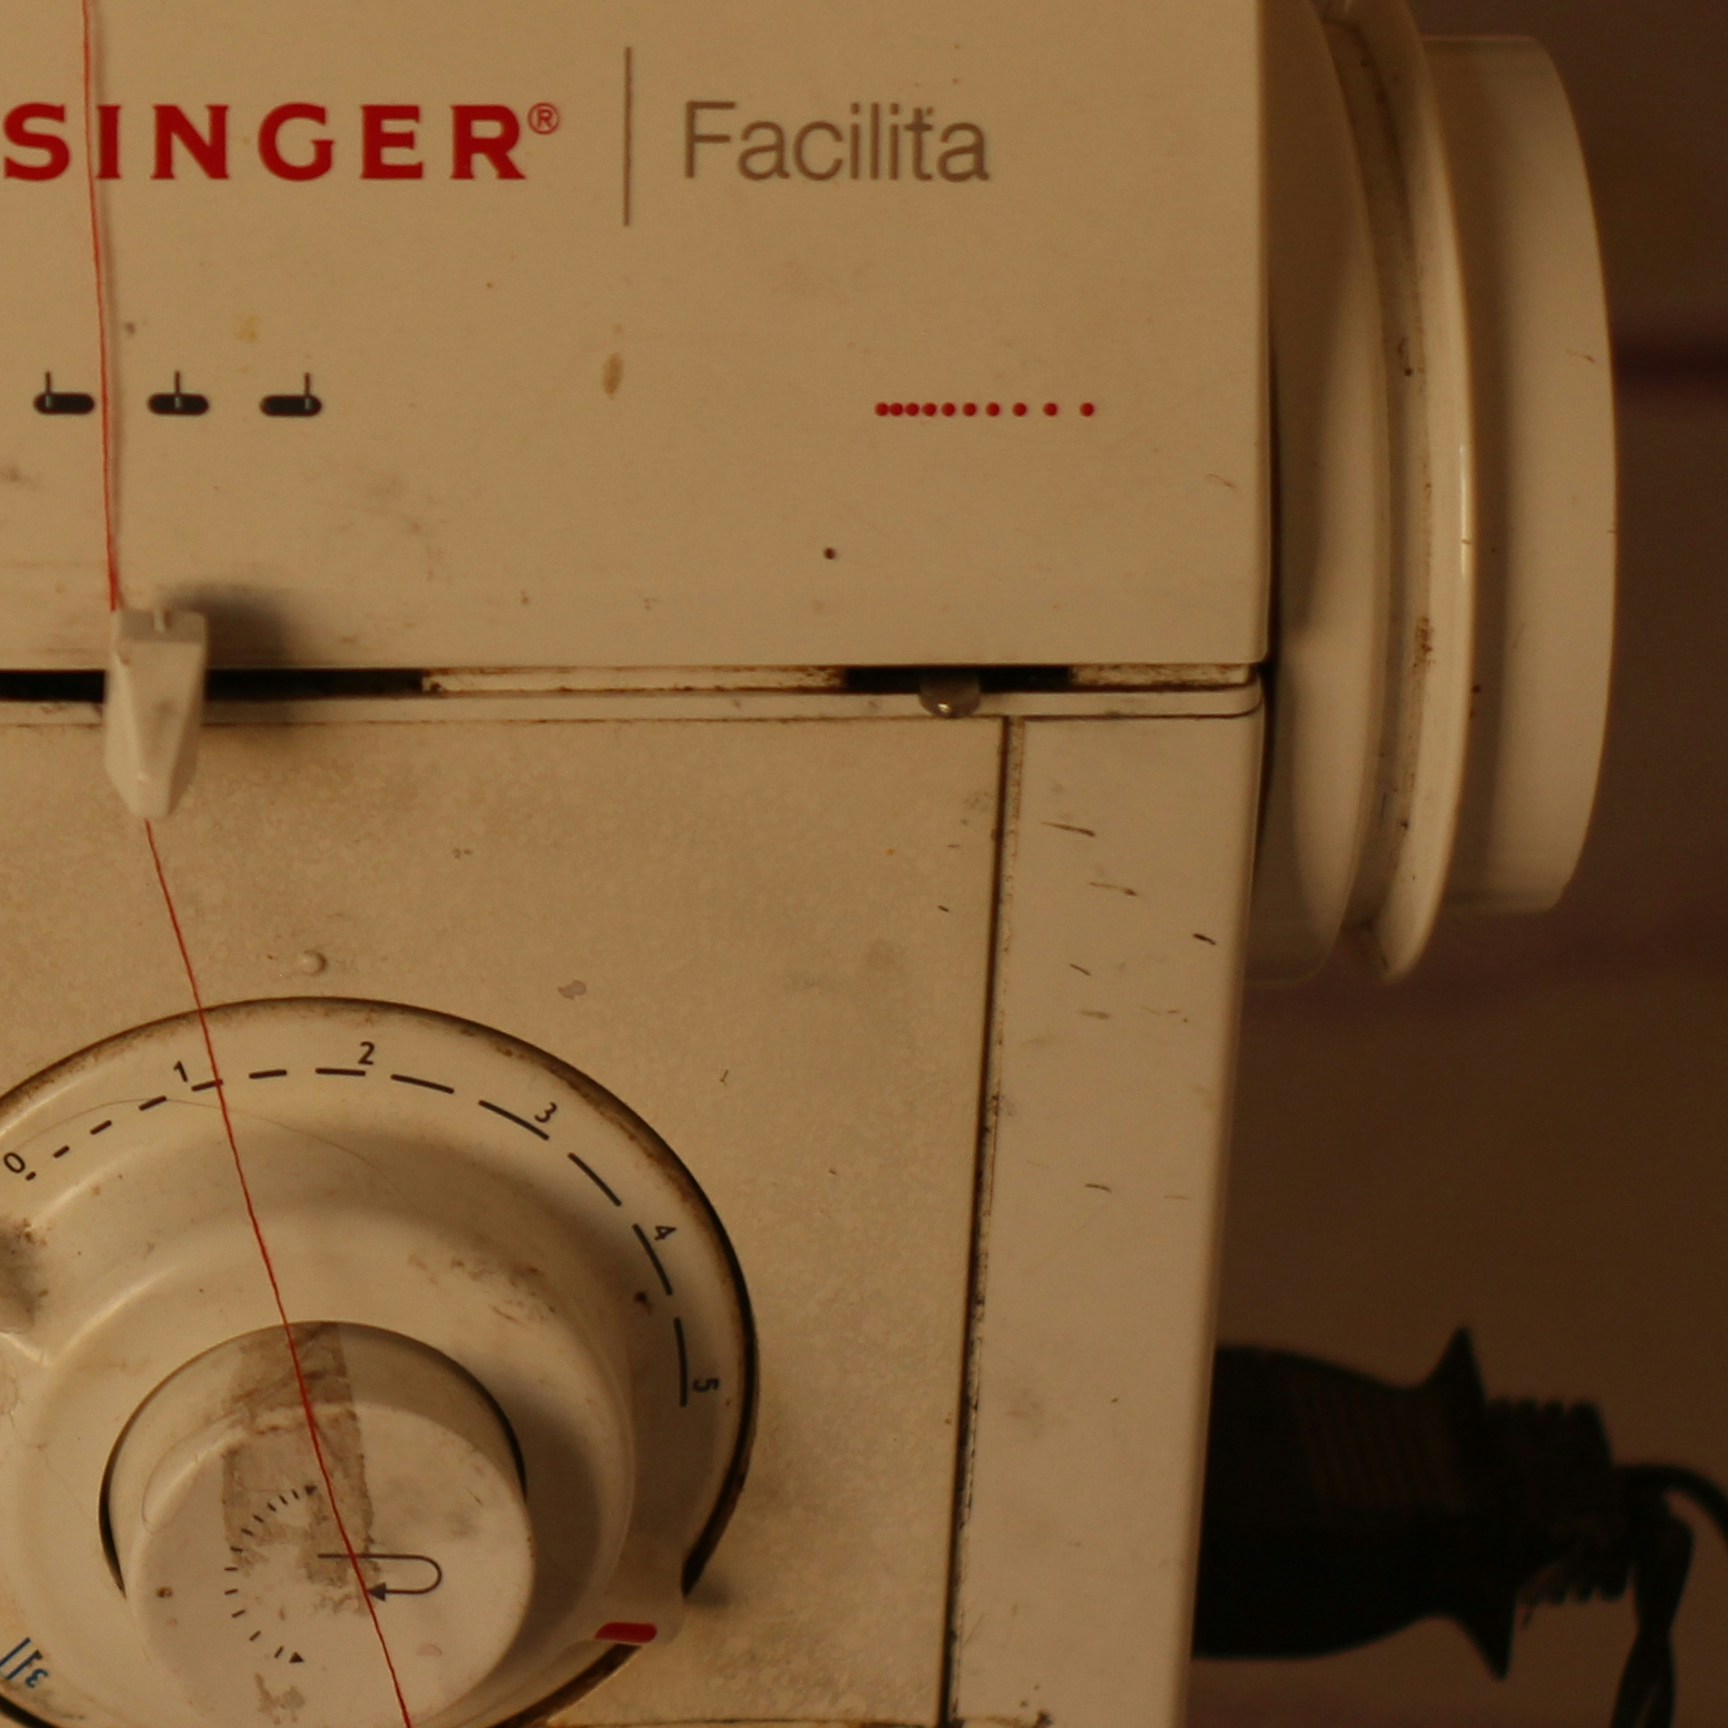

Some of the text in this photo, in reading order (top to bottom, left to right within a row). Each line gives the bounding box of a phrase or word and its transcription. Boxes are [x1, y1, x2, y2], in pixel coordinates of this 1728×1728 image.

[685, 100, 990, 183] Facilita
[357, 1041, 375, 1066] 2
[173, 1060, 189, 1083] 1
[534, 1101, 558, 1124] 3
[2, 1151, 26, 1174] 0
[653, 1224, 678, 1241] 4
[692, 1377, 720, 1394] 5
